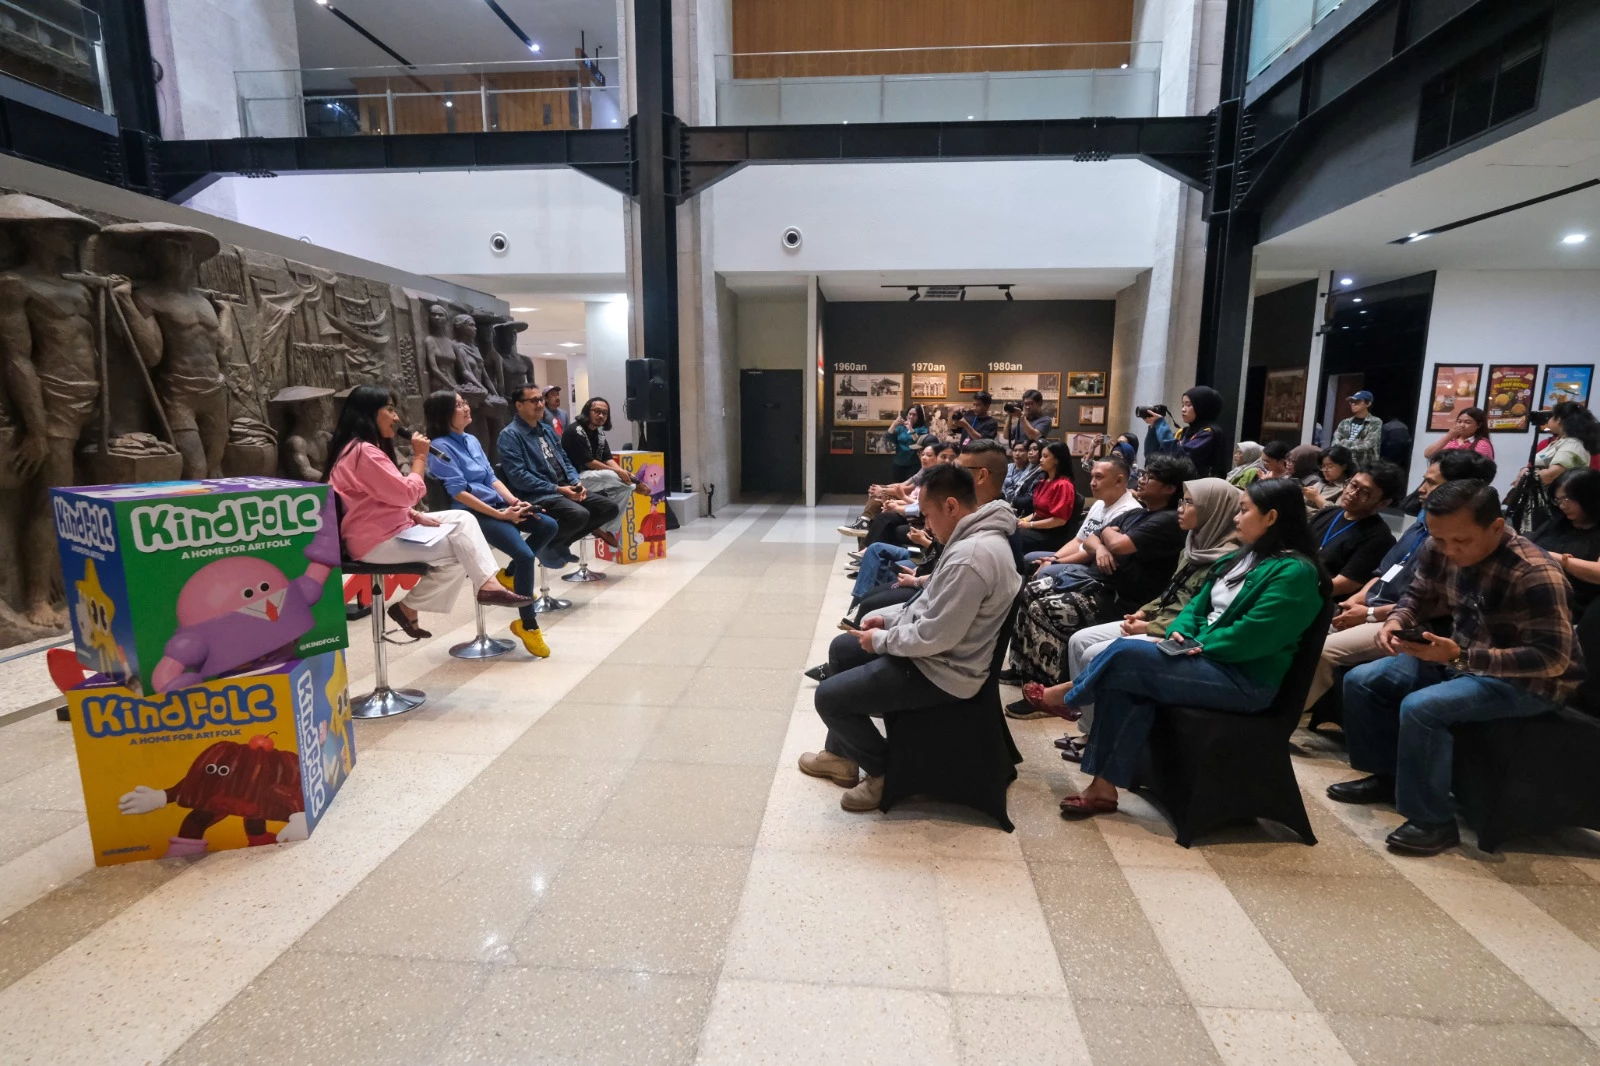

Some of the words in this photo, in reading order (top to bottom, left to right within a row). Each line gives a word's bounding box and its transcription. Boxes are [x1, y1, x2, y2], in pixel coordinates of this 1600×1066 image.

[834, 362, 868, 371] 1960an
[911, 362, 946, 371] 1970an
[987, 361, 1023, 371] 1980an
[181, 551, 190, 560] A
[191, 547, 224, 558] HOME
[225, 545, 246, 554] FOR
[247, 542, 266, 551] ART
[266, 539, 292, 549] FOLK
[299, 635, 340, 651] @KINDFOLC
[139, 735, 171, 744] HOME
[172, 733, 194, 741] FOR
[196, 731, 214, 739] ART
[215, 729, 242, 738] FOLK
